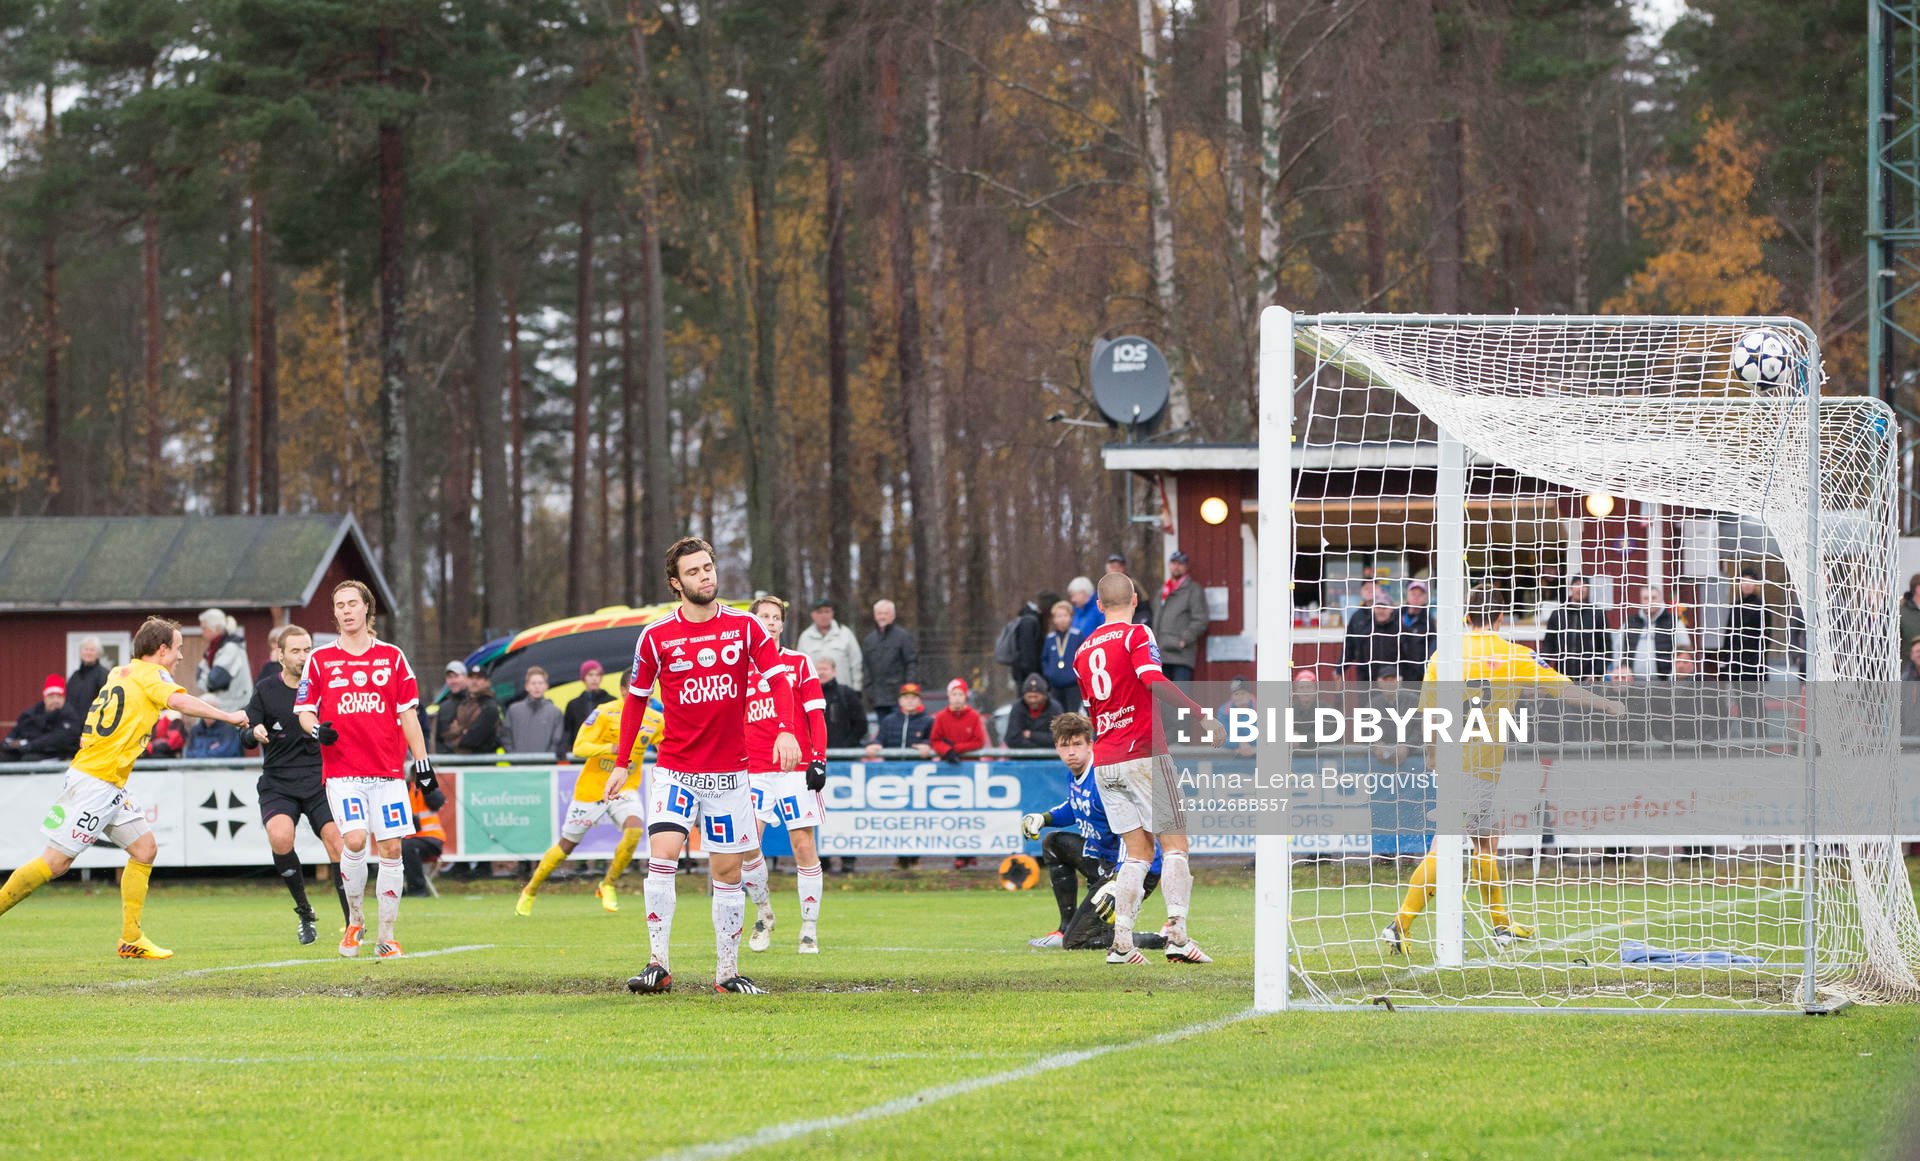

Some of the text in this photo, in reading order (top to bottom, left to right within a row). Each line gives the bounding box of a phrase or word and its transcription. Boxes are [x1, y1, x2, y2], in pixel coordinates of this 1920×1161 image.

[720, 629, 740, 641] AVIS
[1088, 647, 1112, 701] 8
[684, 673, 733, 692] OUTO
[341, 692, 381, 704] OUTO
[679, 684, 738, 705] KUMPU
[337, 701, 386, 715] KUMPU
[749, 697, 776, 713] OUT
[747, 708, 777, 723] KUM
[669, 770, 738, 791] Wafab Bil
[824, 764, 1022, 810] defab
[470, 792, 541, 806] Konferens
[656, 801, 662, 814] 3
[76, 811, 100, 832] 20
[482, 812, 529, 827] Udden
[855, 816, 986, 831] DEGERFORS
[1202, 814, 1334, 829] DEGEORS
[821, 832, 1020, 850] FÖRZINKNINGS AB
